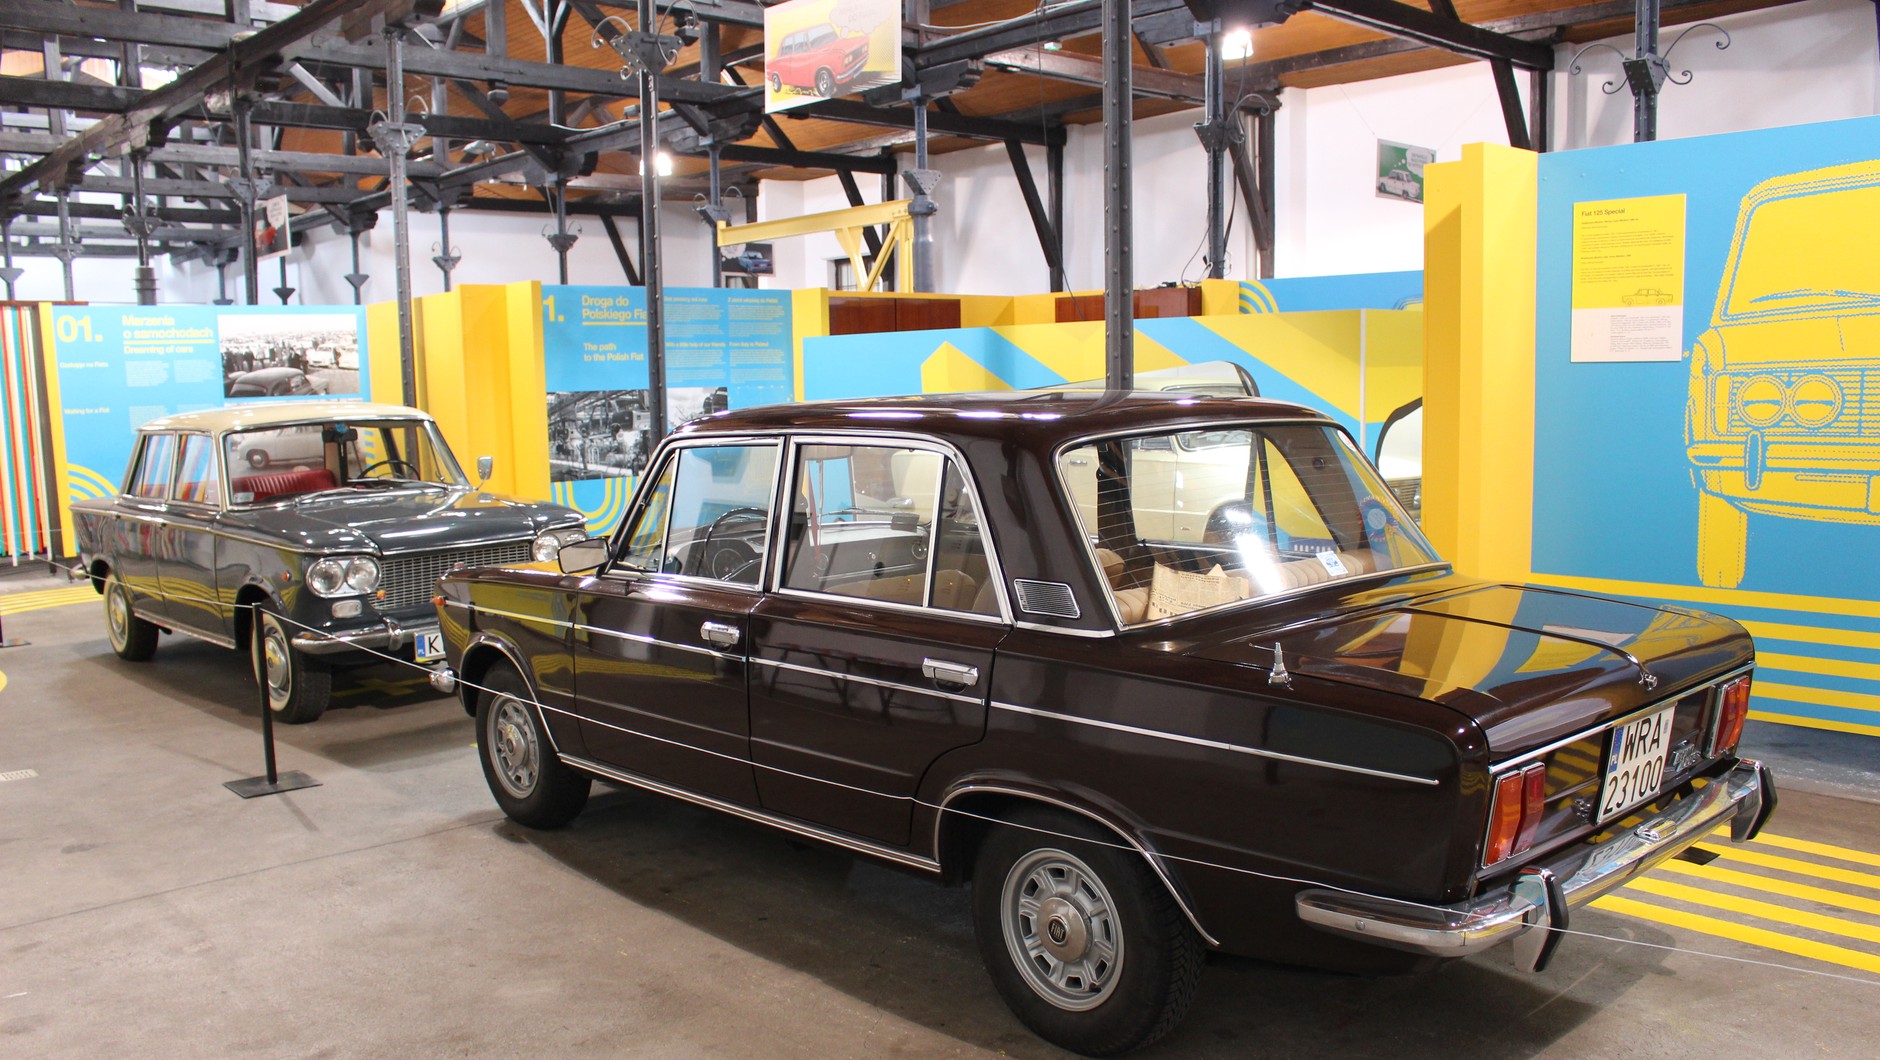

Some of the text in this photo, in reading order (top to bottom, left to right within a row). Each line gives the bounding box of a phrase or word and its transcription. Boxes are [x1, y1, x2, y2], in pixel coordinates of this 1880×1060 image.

[1604, 207, 1626, 216] Special
[582, 295, 629, 308] Droga do
[122, 314, 175, 327] Marzenia
[582, 308, 648, 321] Polskiego Fia
[57, 315, 103, 343] 01.
[123, 327, 214, 339] o samochodach
[123, 345, 194, 355] Dreaming of cars
[583, 343, 616, 352] The path
[584, 352, 645, 361] to the Polish Fiat
[1622, 712, 1662, 764] WRA
[1602, 755, 1663, 815] 23100
[1051, 922, 1064, 939] FIAT
